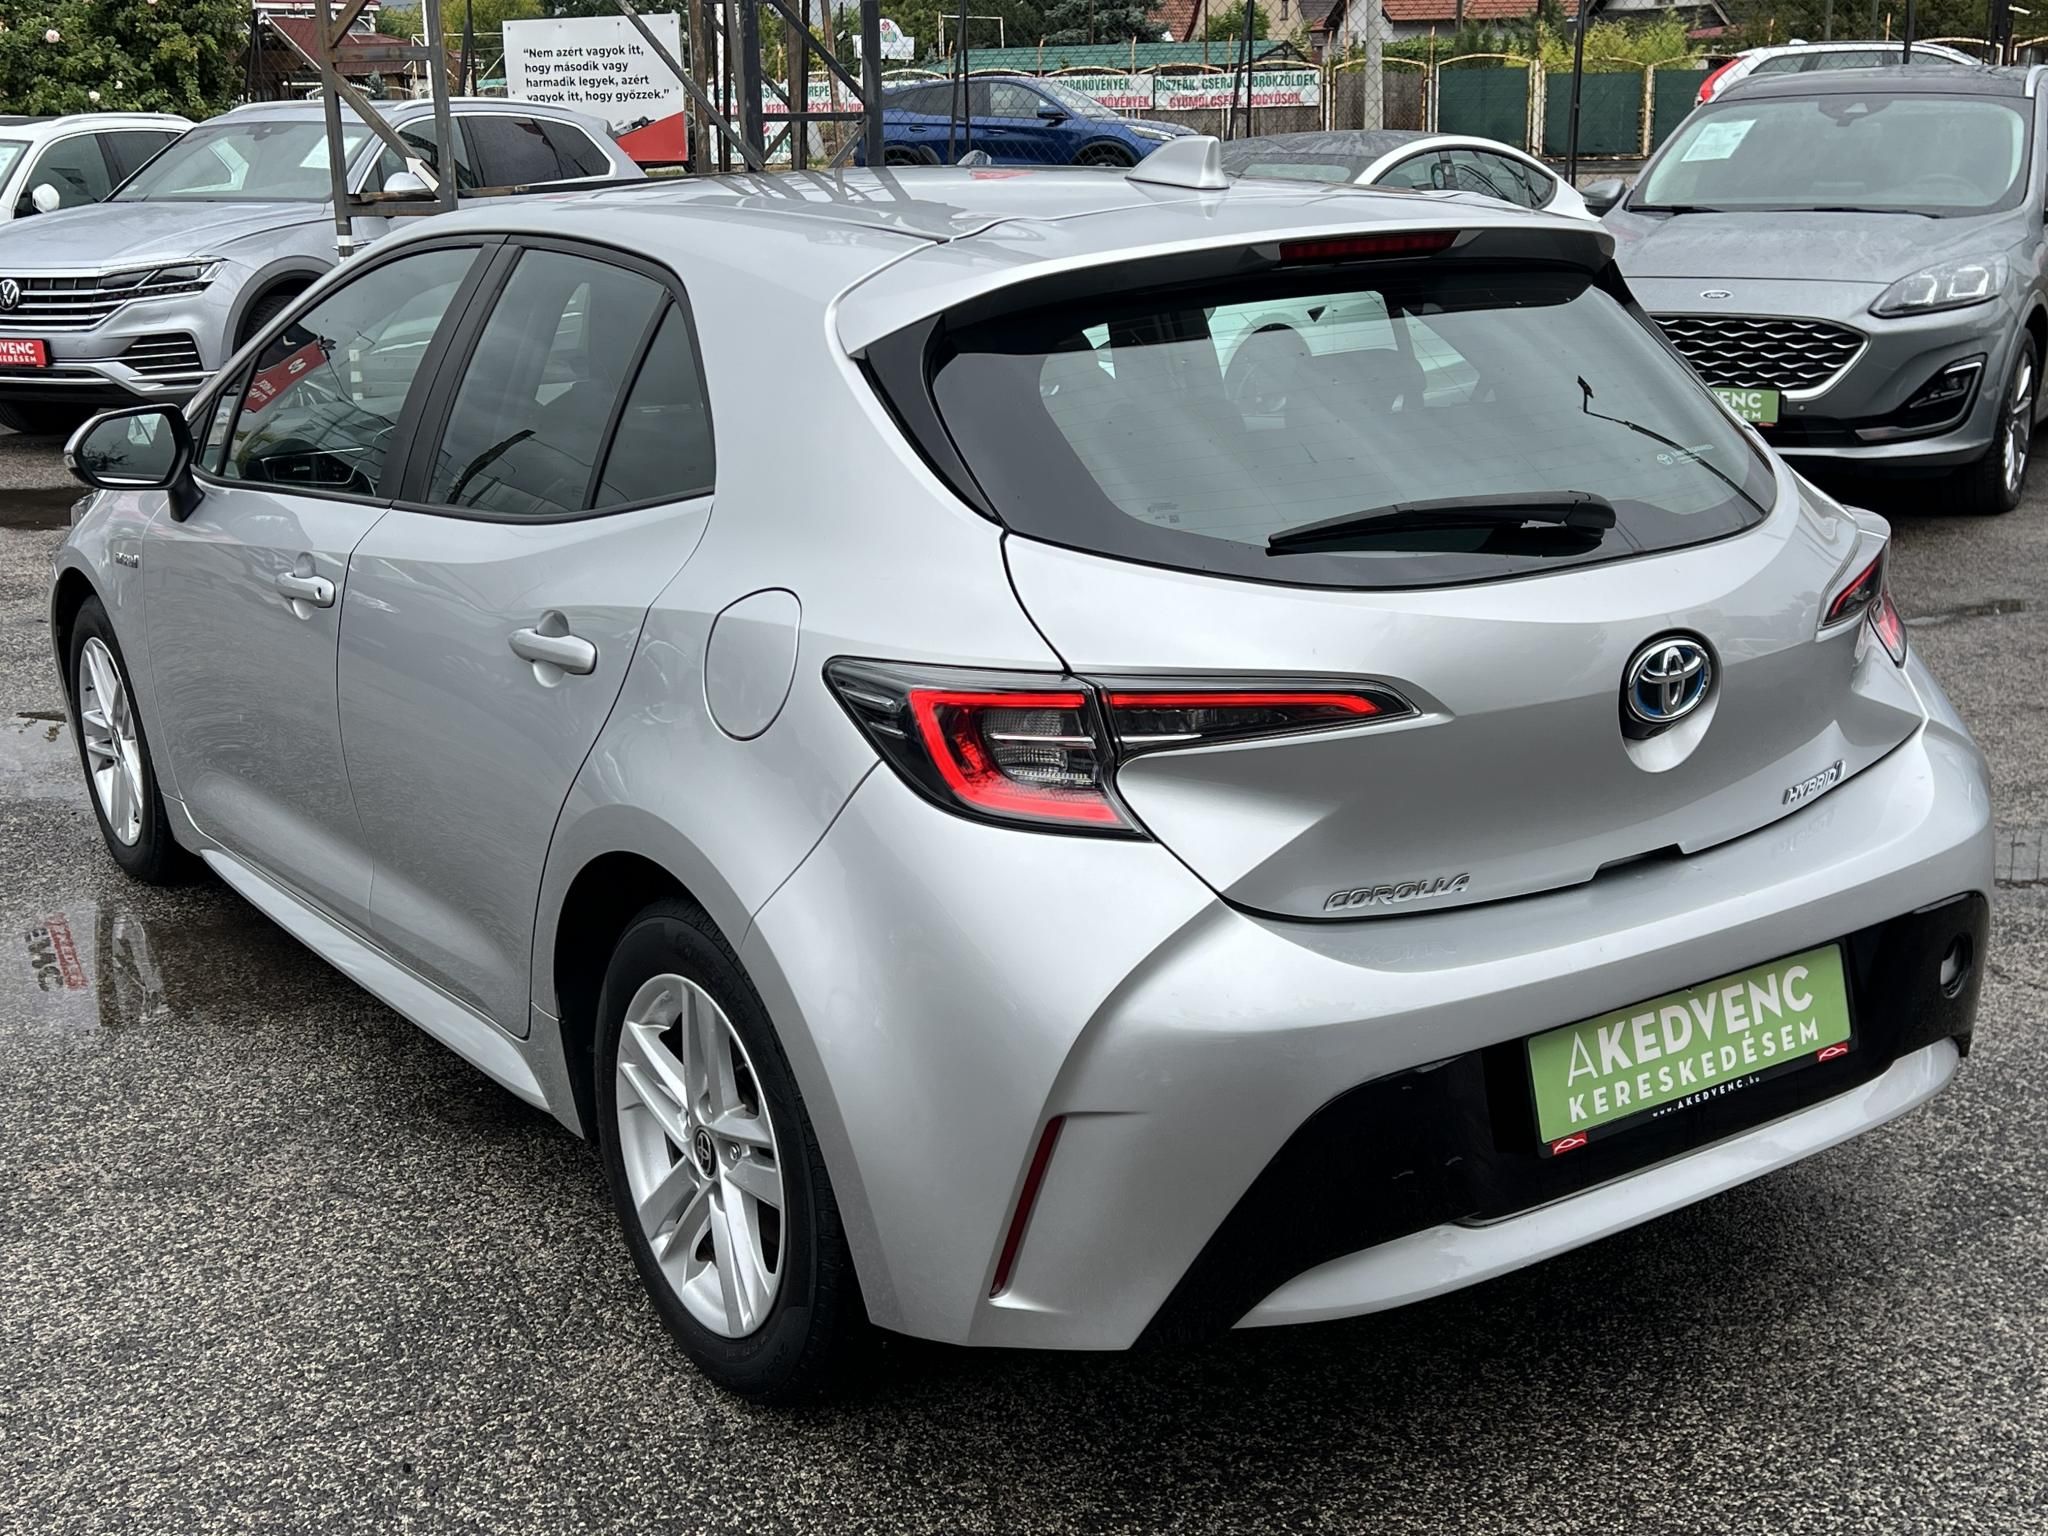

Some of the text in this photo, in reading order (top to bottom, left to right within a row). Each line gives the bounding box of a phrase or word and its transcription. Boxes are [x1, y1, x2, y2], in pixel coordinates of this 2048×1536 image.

[556, 47, 583, 57] azért
[586, 45, 626, 58] vagyok
[628, 44, 644, 56] itt,
[525, 61, 629, 74] hogy második vagy
[526, 74, 650, 88] harmadik legyek, azért
[527, 91, 565, 102] vagyok
[567, 91, 583, 102] itt,
[585, 90, 613, 102] hogy
[1782, 762, 1841, 805] HYBRID
[1323, 872, 1471, 912] COROLLA
[1568, 1015, 1820, 1124] KERESKEDÉSEM
